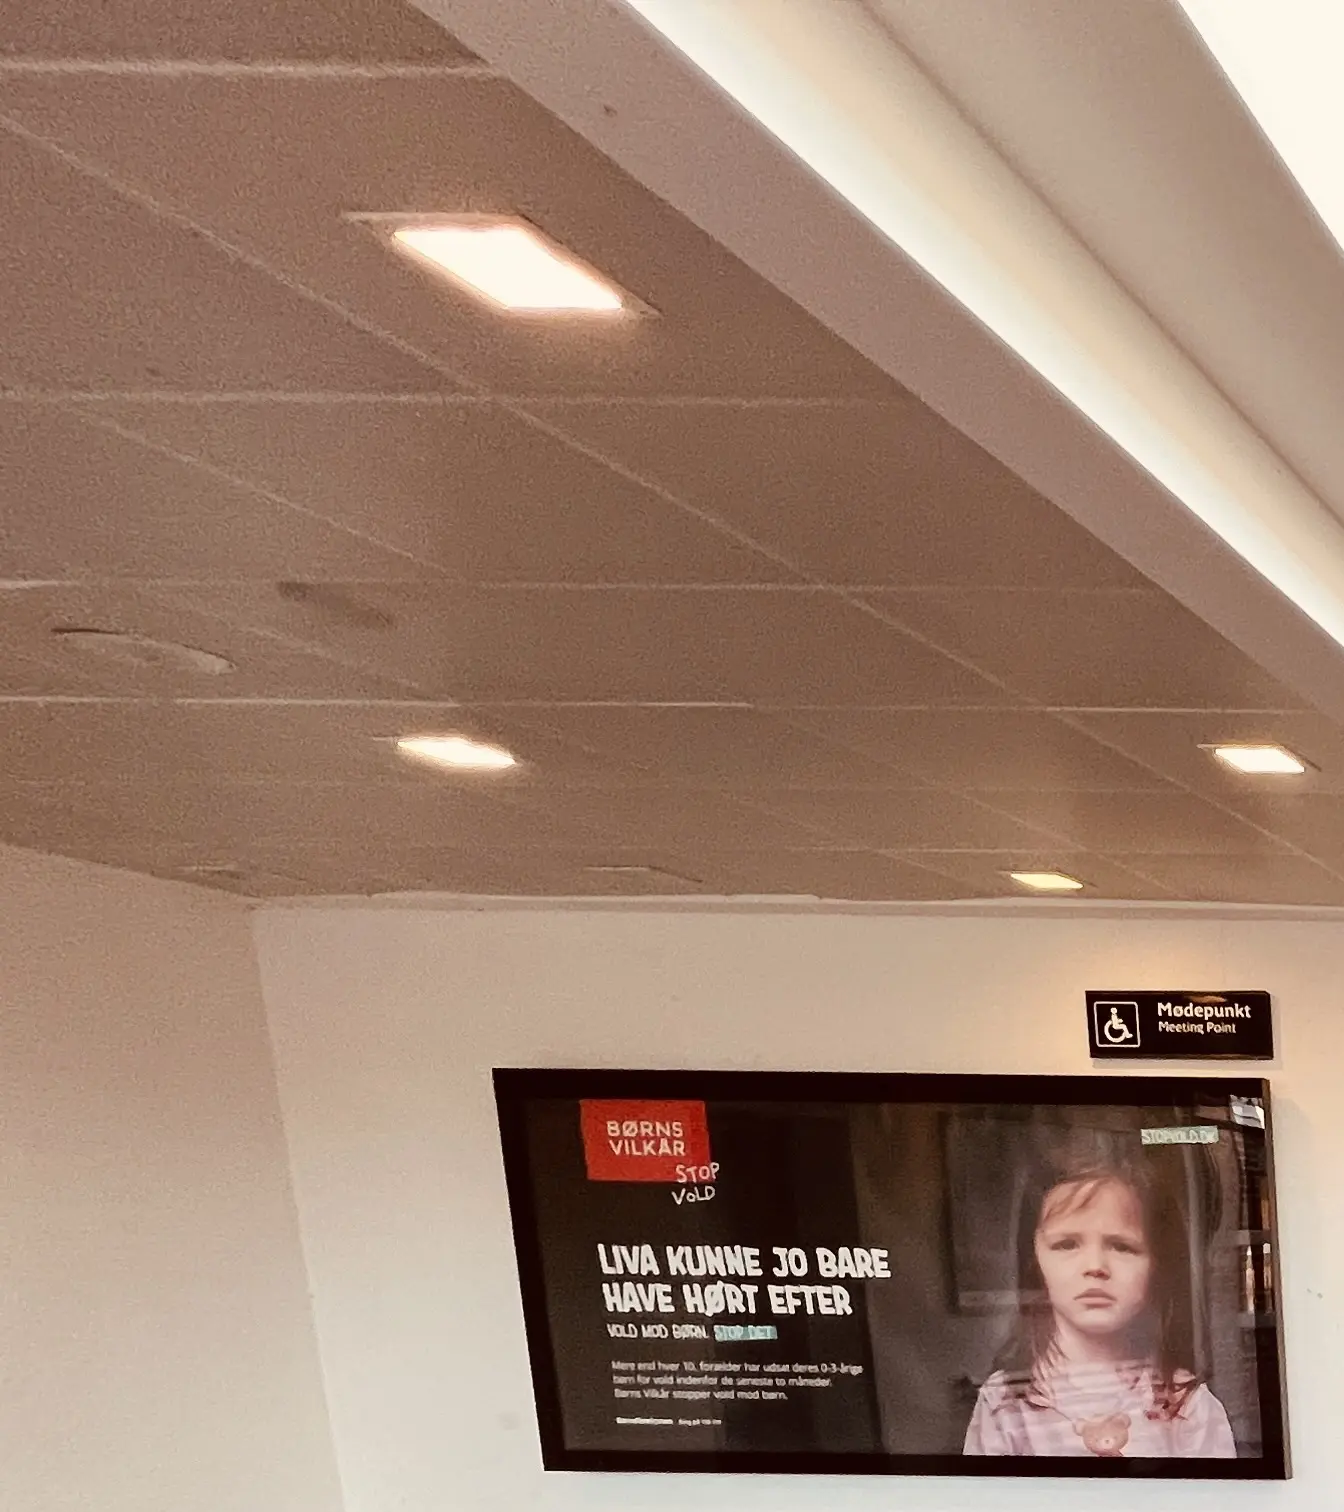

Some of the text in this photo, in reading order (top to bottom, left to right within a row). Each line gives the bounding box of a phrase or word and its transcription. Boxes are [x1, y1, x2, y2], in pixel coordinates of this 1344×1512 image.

[1157, 1002, 1251, 1020] Mødepunkt
[1158, 1021, 1236, 1034] Meeting Point
[606, 1120, 683, 1137] BØRNS
[609, 1137, 686, 1156] VILKÅR
[675, 1162, 720, 1183] STOP
[597, 1243, 892, 1278] LIVA KUNNE JO BARE
[602, 1280, 852, 1317] HAVE HØRT EFTER
[607, 1323, 638, 1338] VOLD
[641, 1324, 668, 1339] MOD
